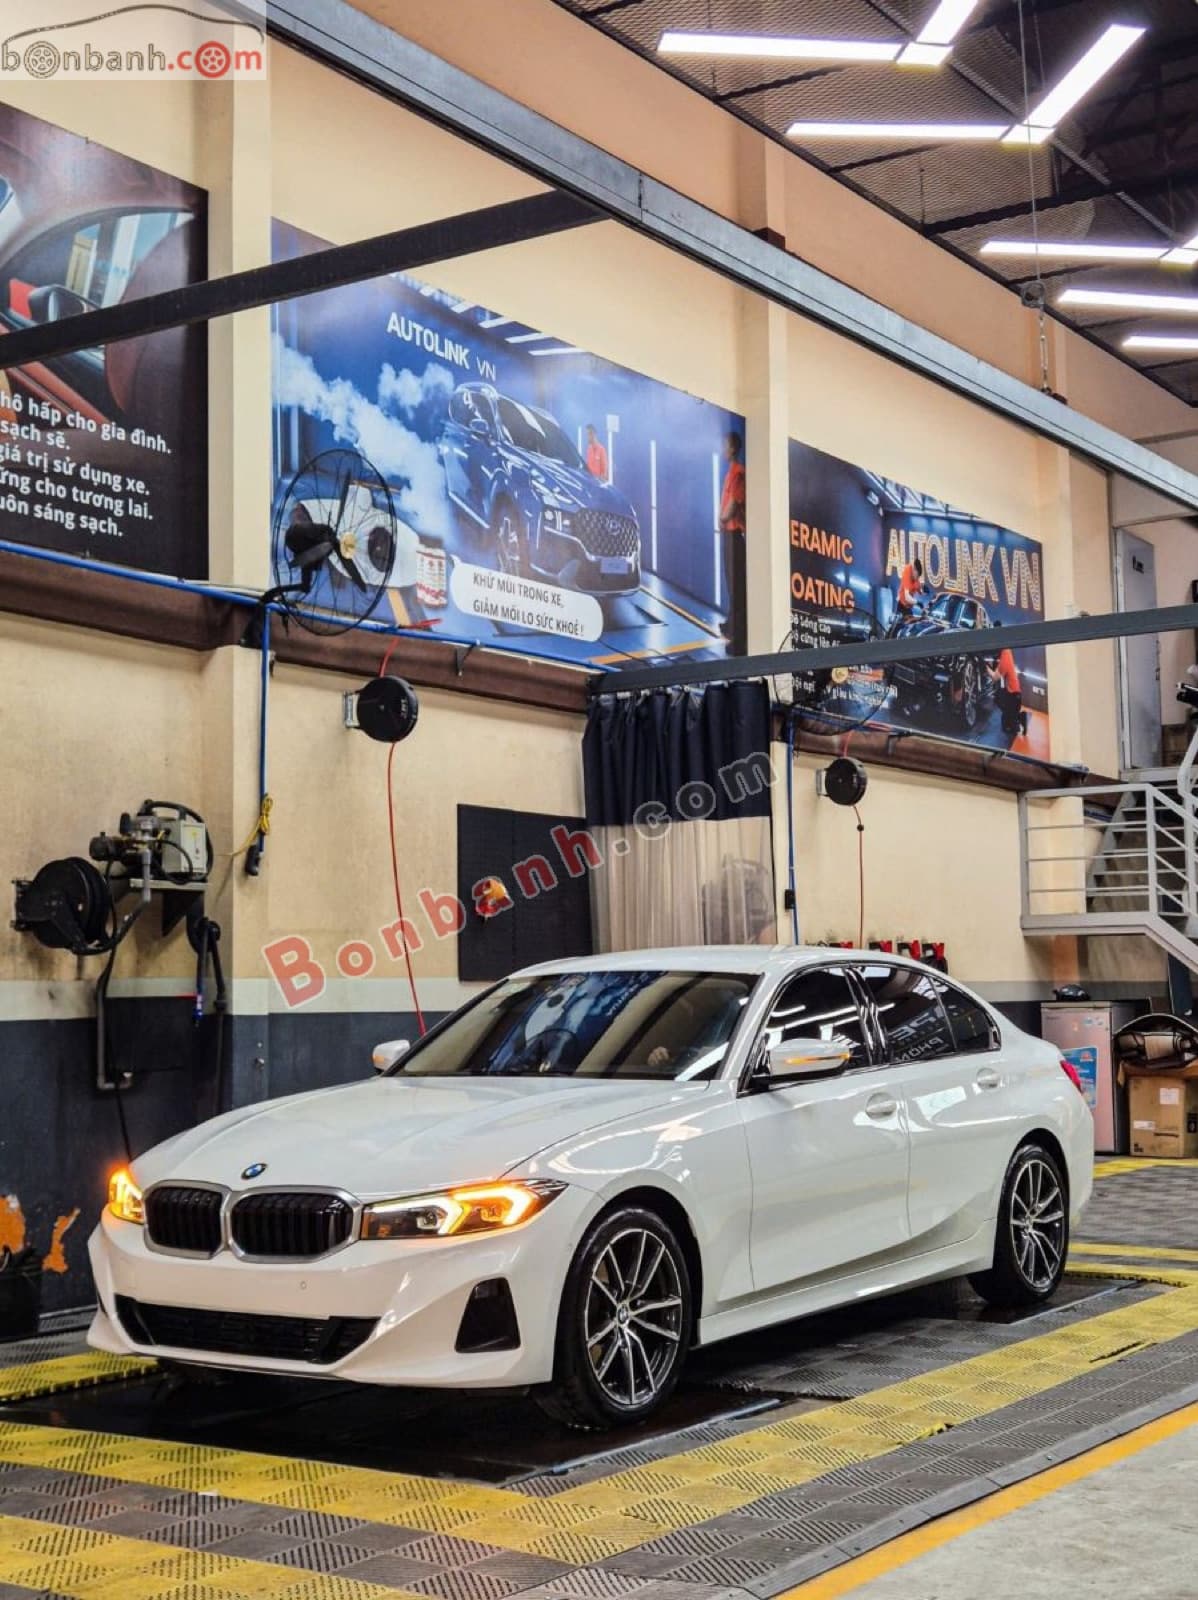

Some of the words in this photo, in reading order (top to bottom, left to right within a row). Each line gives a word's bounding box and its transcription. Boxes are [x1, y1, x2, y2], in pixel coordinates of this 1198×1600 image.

[387, 312, 470, 370] AUTOLINK
[476, 355, 496, 382] VN
[0, 423, 41, 442] sạch
[46, 431, 71, 450] sẽ.
[28, 397, 61, 426] hấp
[66, 411, 96, 432] cho
[101, 421, 125, 441] gia
[131, 428, 172, 454] đình.
[26, 450, 48, 473] trị
[53, 456, 76, 476] sử
[80, 463, 122, 492] dụng
[126, 477, 150, 495] xe.
[33, 502, 75, 530] sáng
[80, 516, 123, 537] sạch.
[35, 477, 66, 498] cho
[72, 485, 124, 517] tương
[128, 498, 153, 520] lai.
[886, 528, 999, 602] AUTOLINK
[1000, 547, 1041, 611] VN
[518, 583, 549, 603] TRONG
[521, 611, 534, 626] LO
